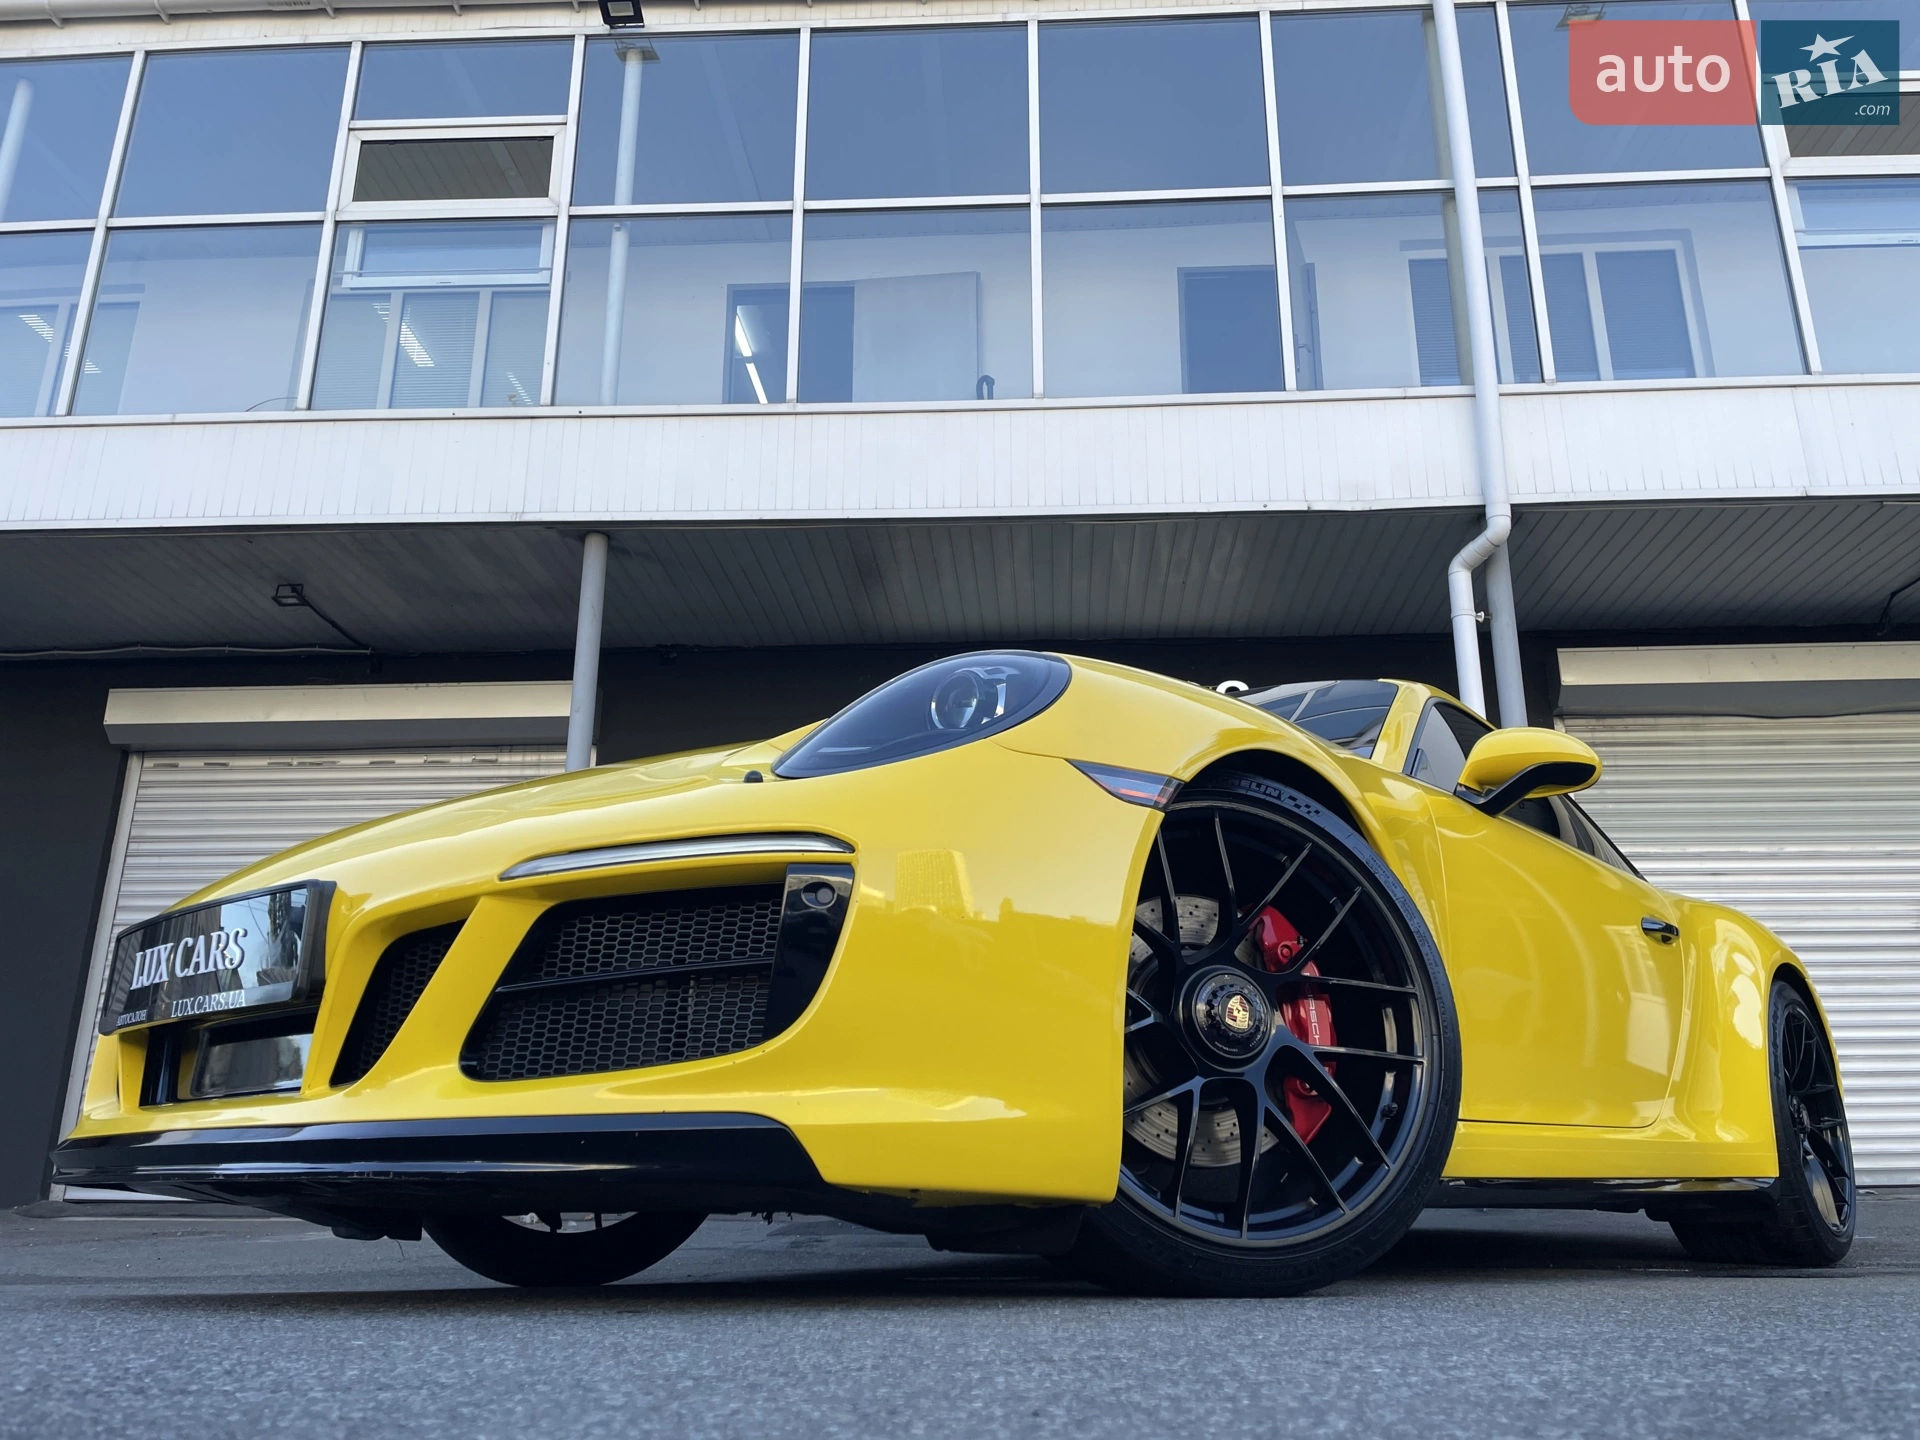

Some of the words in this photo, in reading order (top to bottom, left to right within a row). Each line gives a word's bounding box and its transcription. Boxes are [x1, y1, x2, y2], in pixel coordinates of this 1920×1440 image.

[130, 941, 175, 990] LUX
[174, 927, 248, 978] CARS
[170, 989, 247, 1019] LUX.CARS.UA
